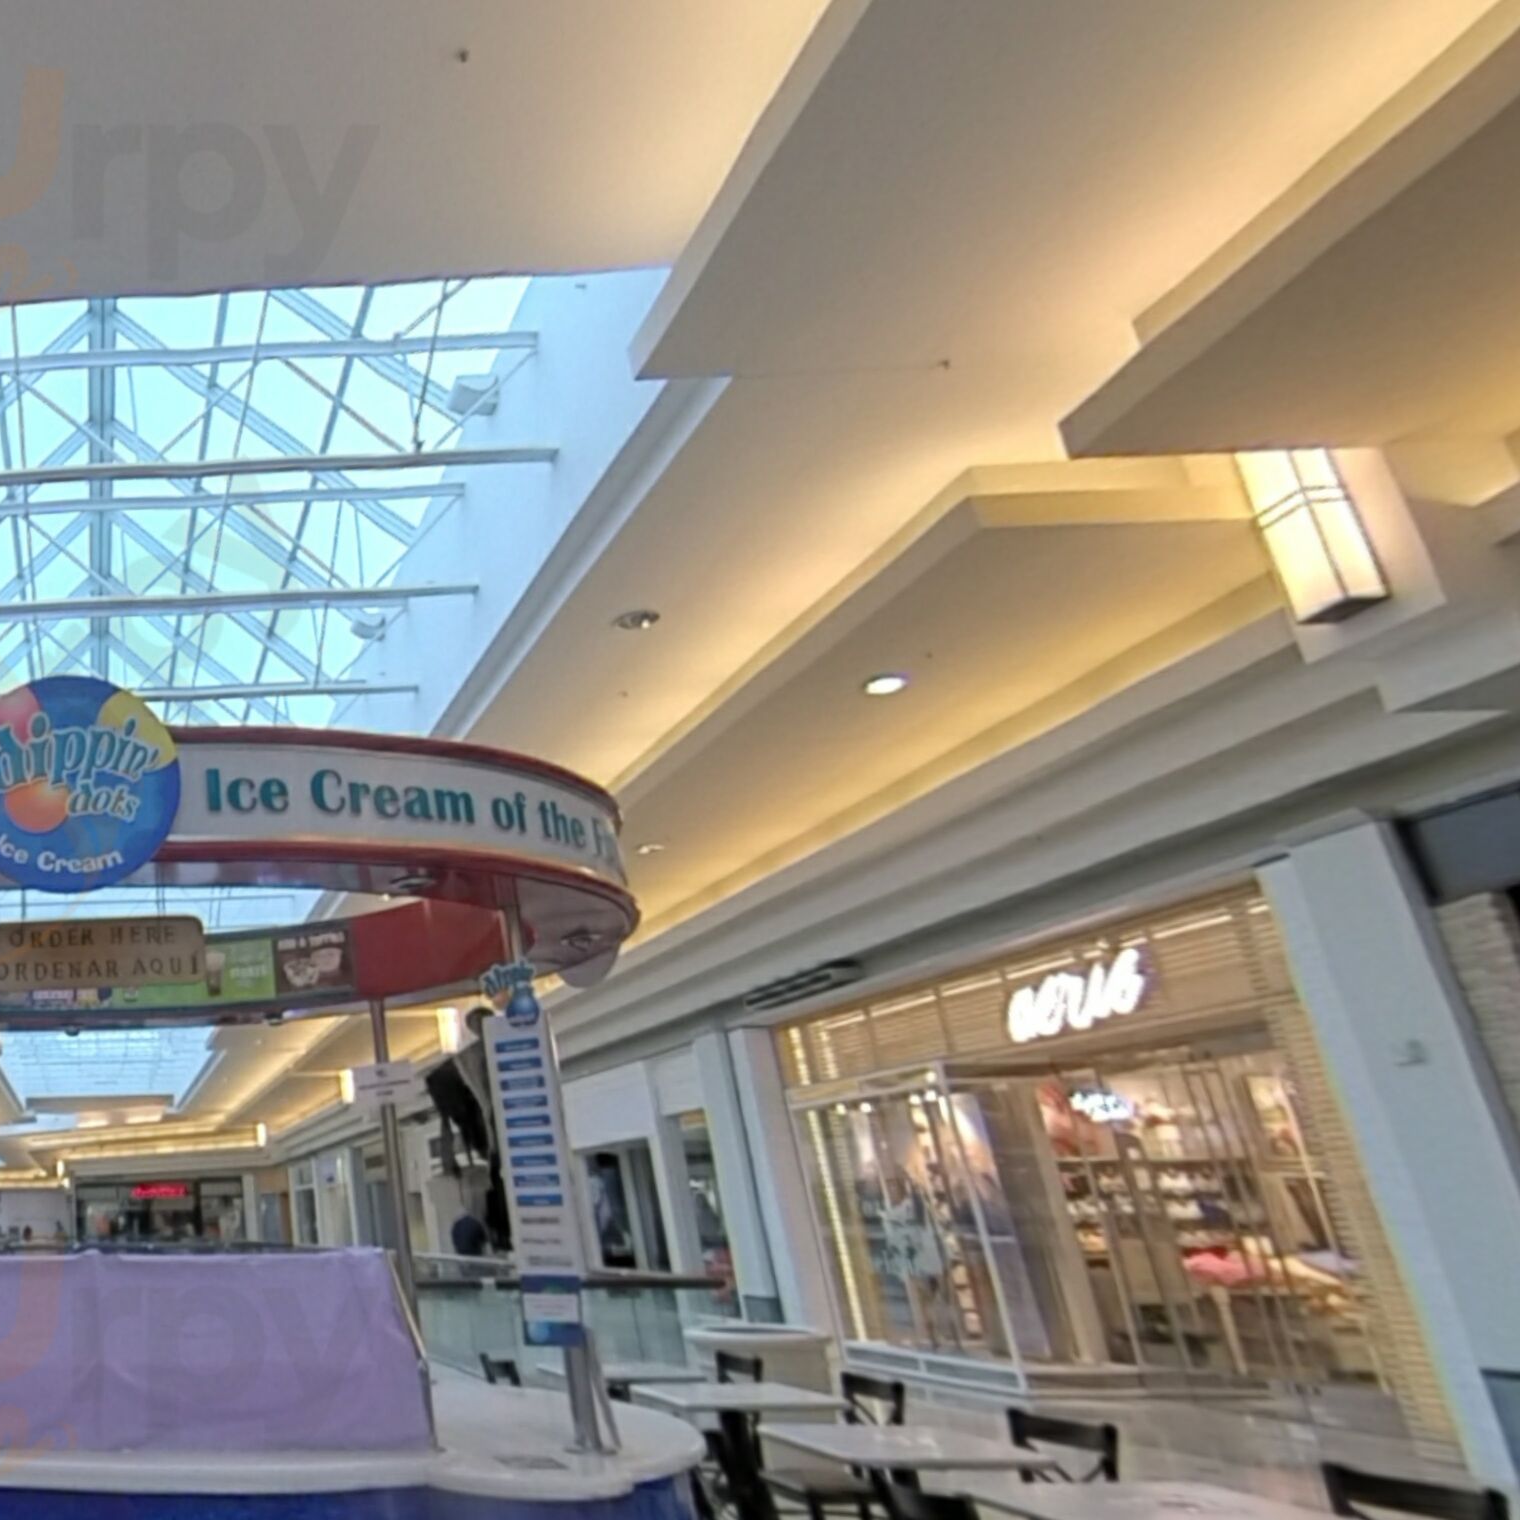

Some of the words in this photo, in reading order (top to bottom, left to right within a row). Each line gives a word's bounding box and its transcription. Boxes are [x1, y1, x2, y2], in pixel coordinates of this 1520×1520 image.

[67, 781, 139, 823] dots
[205, 768, 289, 814] Ice
[310, 769, 476, 826] Cream
[491, 791, 527, 835] of
[538, 800, 586, 849] the
[36, 850, 125, 874] Cream
[9, 927, 95, 949] ORDER
[110, 924, 177, 945] HERE
